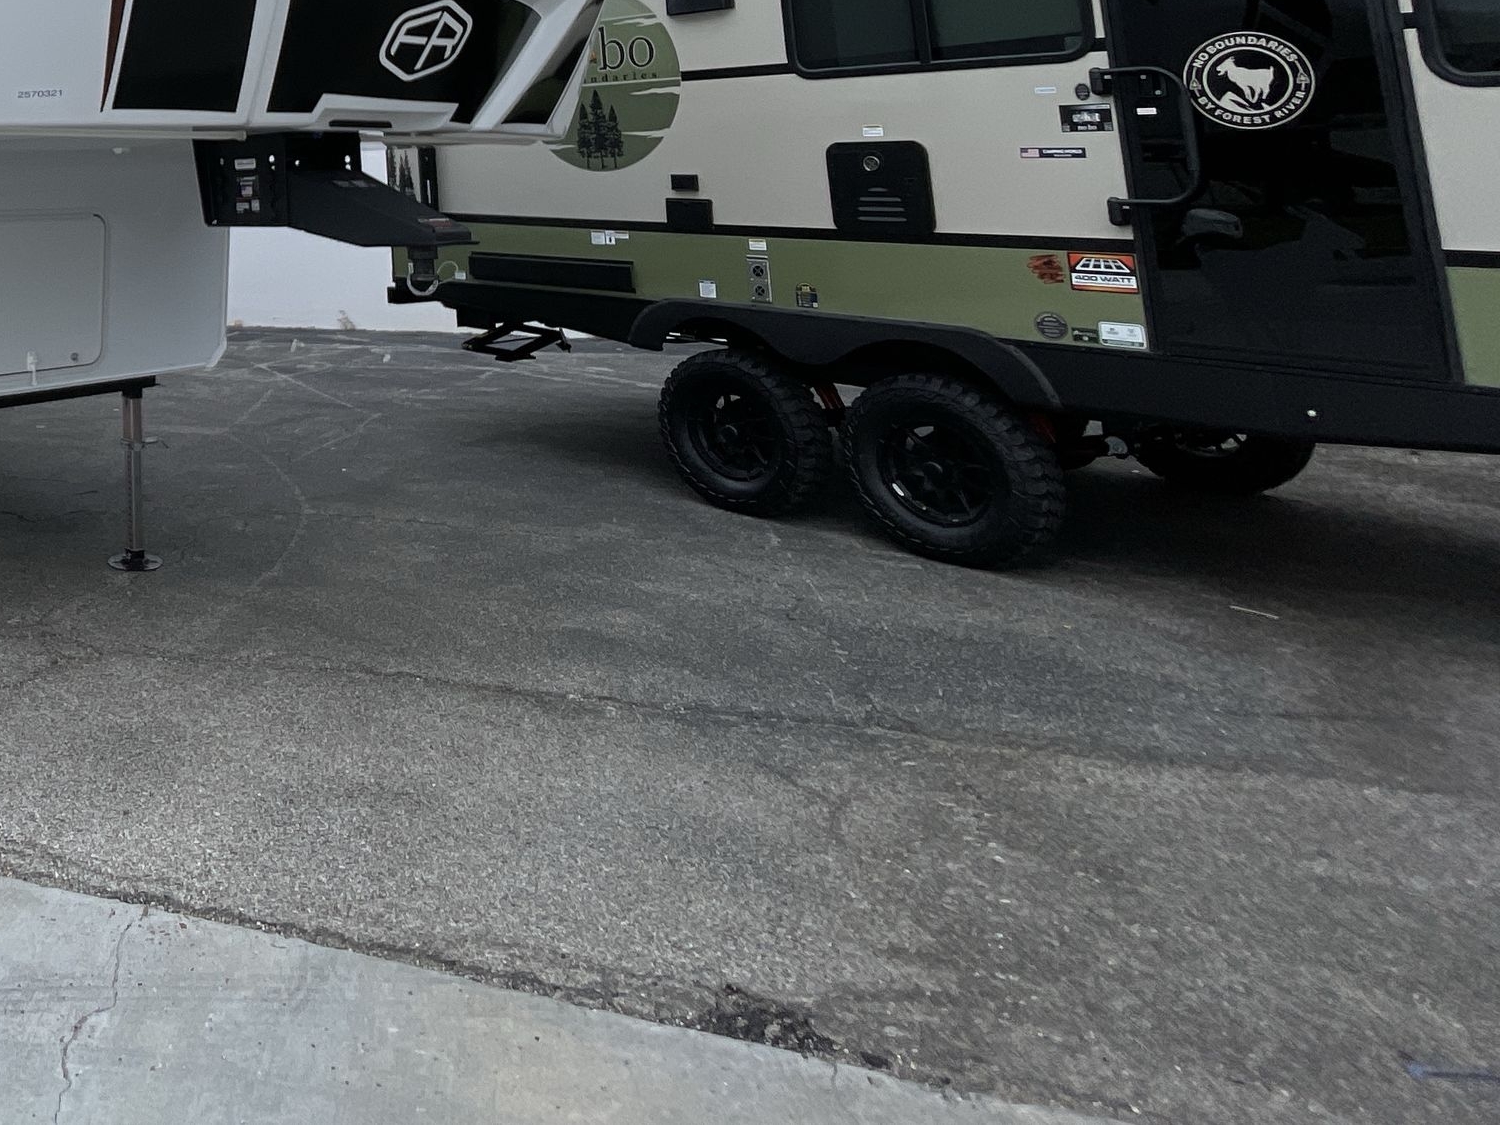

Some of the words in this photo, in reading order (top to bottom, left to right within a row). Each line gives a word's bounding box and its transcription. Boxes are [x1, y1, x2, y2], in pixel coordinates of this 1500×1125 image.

[1192, 52, 1210, 69] NO
[1205, 35, 1298, 62] BOUNDARIES
[1197, 95, 1216, 111] BY
[1214, 108, 1271, 124] FOREST
[1273, 90, 1306, 118] RIVER
[1075, 274, 1098, 283] 400
[1100, 276, 1133, 284] WATT
